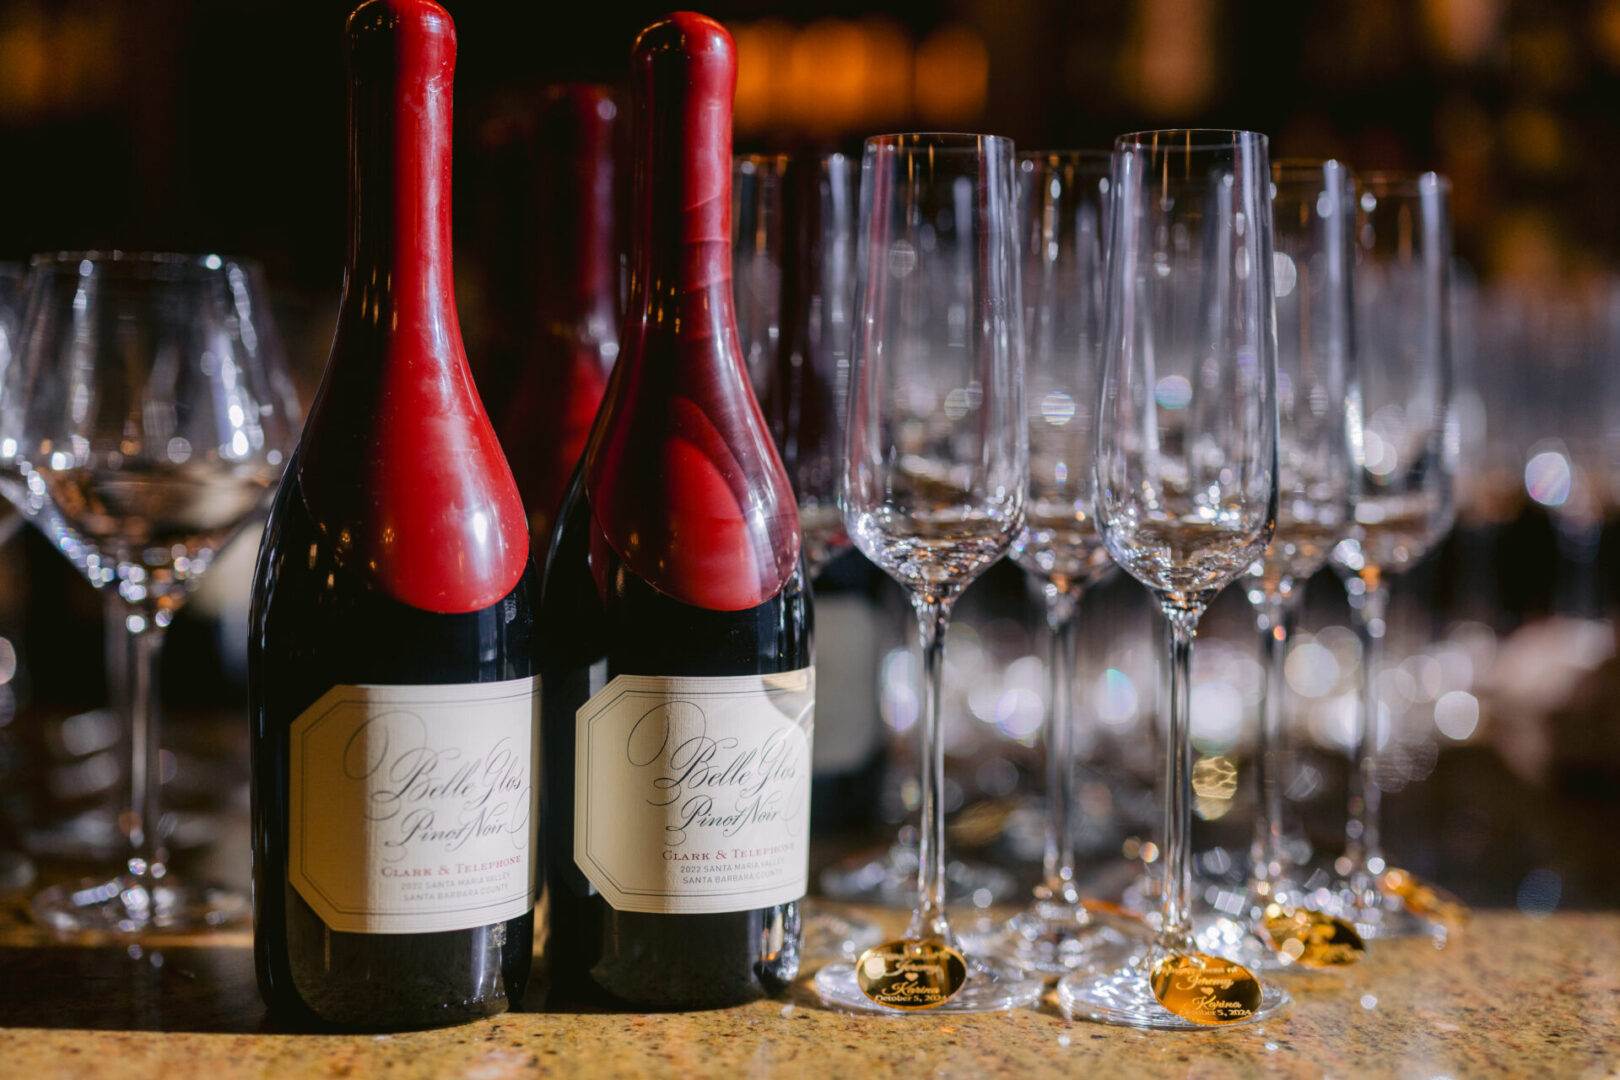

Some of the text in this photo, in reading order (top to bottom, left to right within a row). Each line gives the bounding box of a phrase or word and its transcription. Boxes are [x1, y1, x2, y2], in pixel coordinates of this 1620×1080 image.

[646, 729, 797, 806] Belle Glos
[365, 737, 524, 821] Belle Glos
[665, 792, 783, 840] Pinot Noir
[383, 801, 511, 855] Pinot Noir
[662, 849, 711, 861] CLARK
[715, 849, 727, 860] &
[381, 865, 432, 878] CLARK
[438, 864, 450, 876] &
[680, 857, 785, 874] 2022 SANTA MARIA VALLEY
[400, 871, 511, 891] 2022 SANTA MARIA VALLEY
[682, 868, 783, 885] SANTA BARBARA COUNTY
[403, 883, 509, 902] SANTA BARBARA COUNTY
